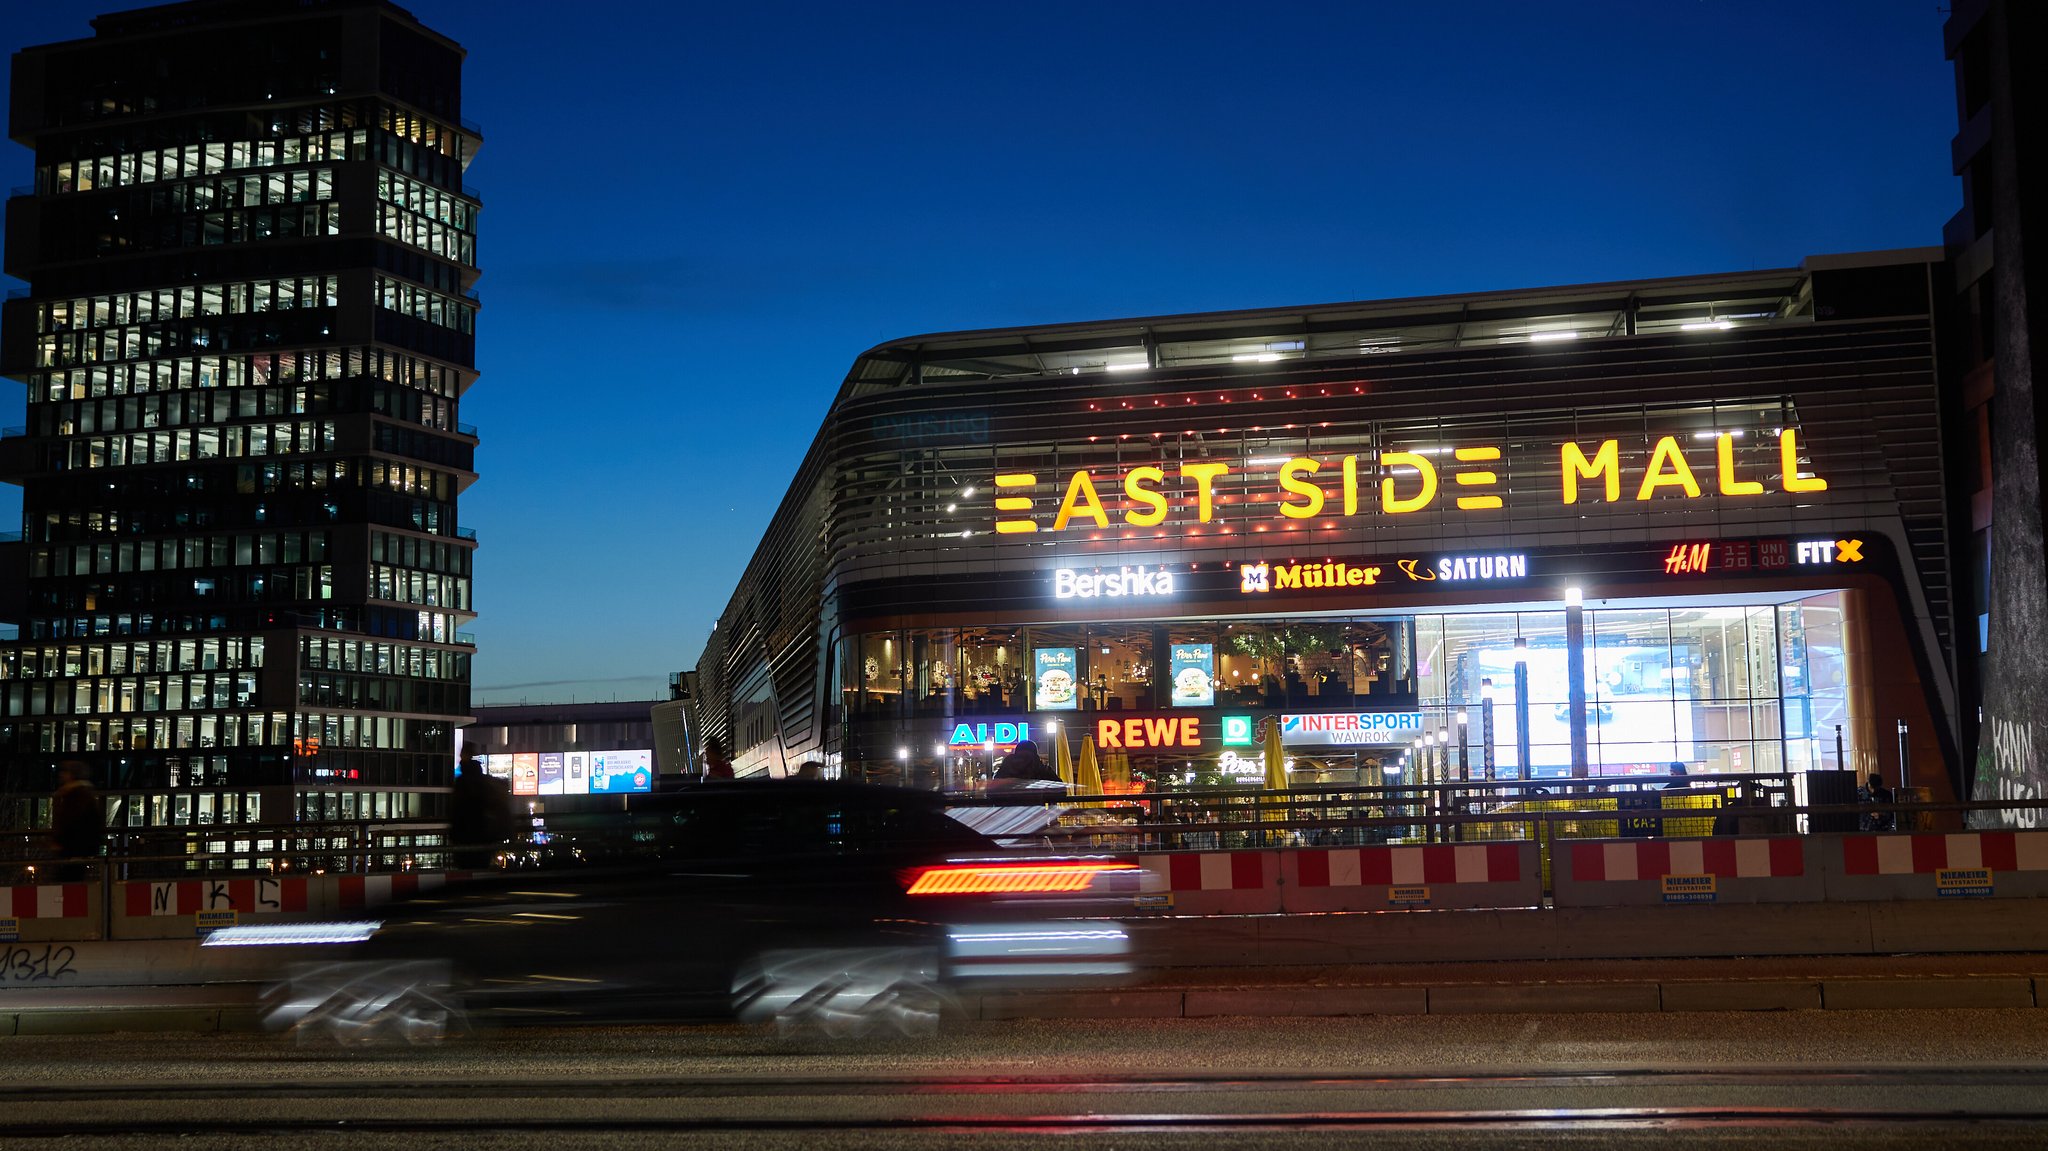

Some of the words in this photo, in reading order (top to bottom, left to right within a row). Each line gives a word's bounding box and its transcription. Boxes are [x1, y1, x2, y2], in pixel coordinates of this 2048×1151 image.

[994, 462, 1230, 535] EAST
[1279, 446, 1503, 520] SIDE
[1560, 428, 1828, 505] MALL
[1664, 542, 1711, 575] H&M
[1760, 543, 1784, 555] UNI
[1761, 556, 1785, 568] QLO
[1274, 562, 1382, 589] Müller
[1439, 554, 1527, 581] SATURN
[1055, 565, 1174, 599] Bershka
[949, 722, 1029, 744] ALDI
[1097, 717, 1202, 748] REWE
[1302, 713, 1422, 731] INTERSPORT
[1332, 731, 1391, 743] WAWROK
[1992, 715, 2033, 777] KANN
[1941, 871, 1988, 879] NIEMEIER
